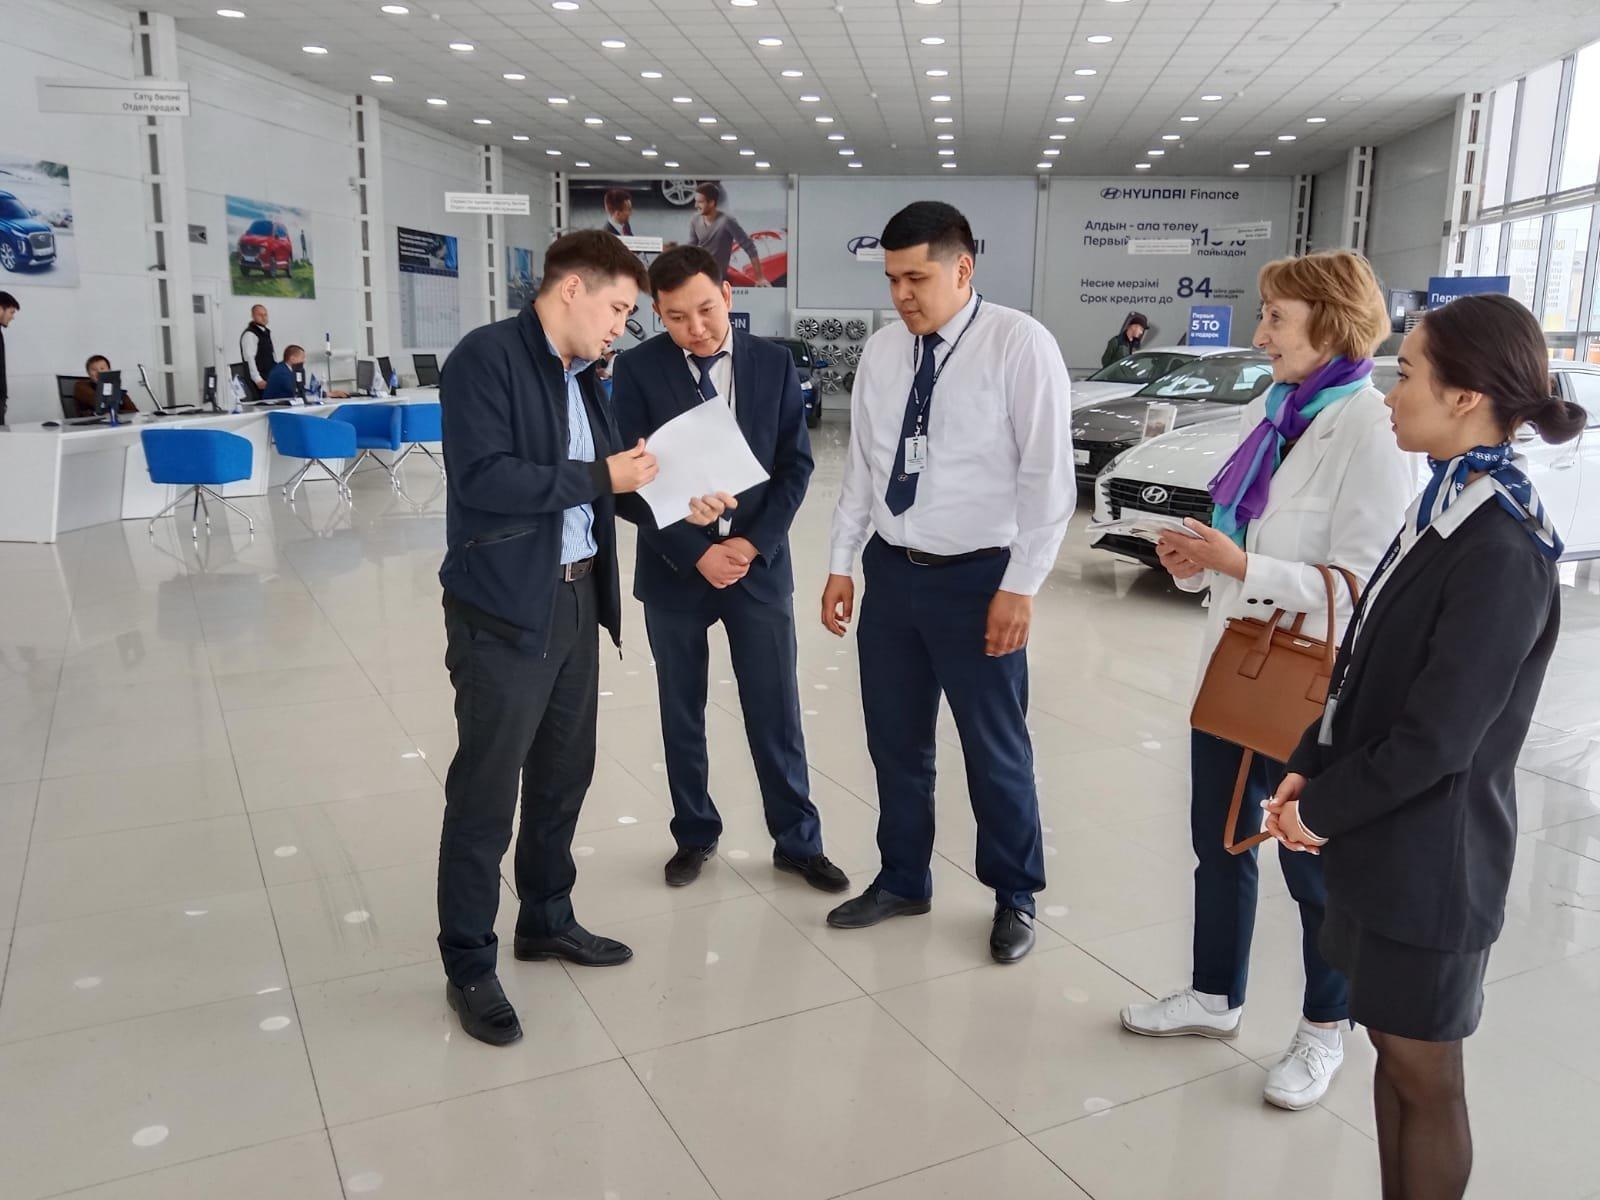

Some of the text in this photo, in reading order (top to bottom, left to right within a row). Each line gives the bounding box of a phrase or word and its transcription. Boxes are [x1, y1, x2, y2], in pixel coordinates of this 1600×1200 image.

[122, 102, 149, 112] Отдел
[1122, 188, 1240, 200] HYUNDAI Finance
[1085, 221, 1127, 232] Алдын
[1136, 222, 1160, 231] ала
[1162, 222, 1199, 233] төлеу
[1083, 235, 1131, 248] Первый
[1197, 247, 1247, 257] пайыздан
[1080, 278, 1115, 288] Несие
[1117, 278, 1160, 289] мерзімі
[1177, 276, 1213, 298] 84
[1080, 294, 1108, 304] Срок
[1110, 295, 1157, 304] кредита
[1159, 296, 1174, 305] до
[1191, 320, 1220, 331] 5 ТО
